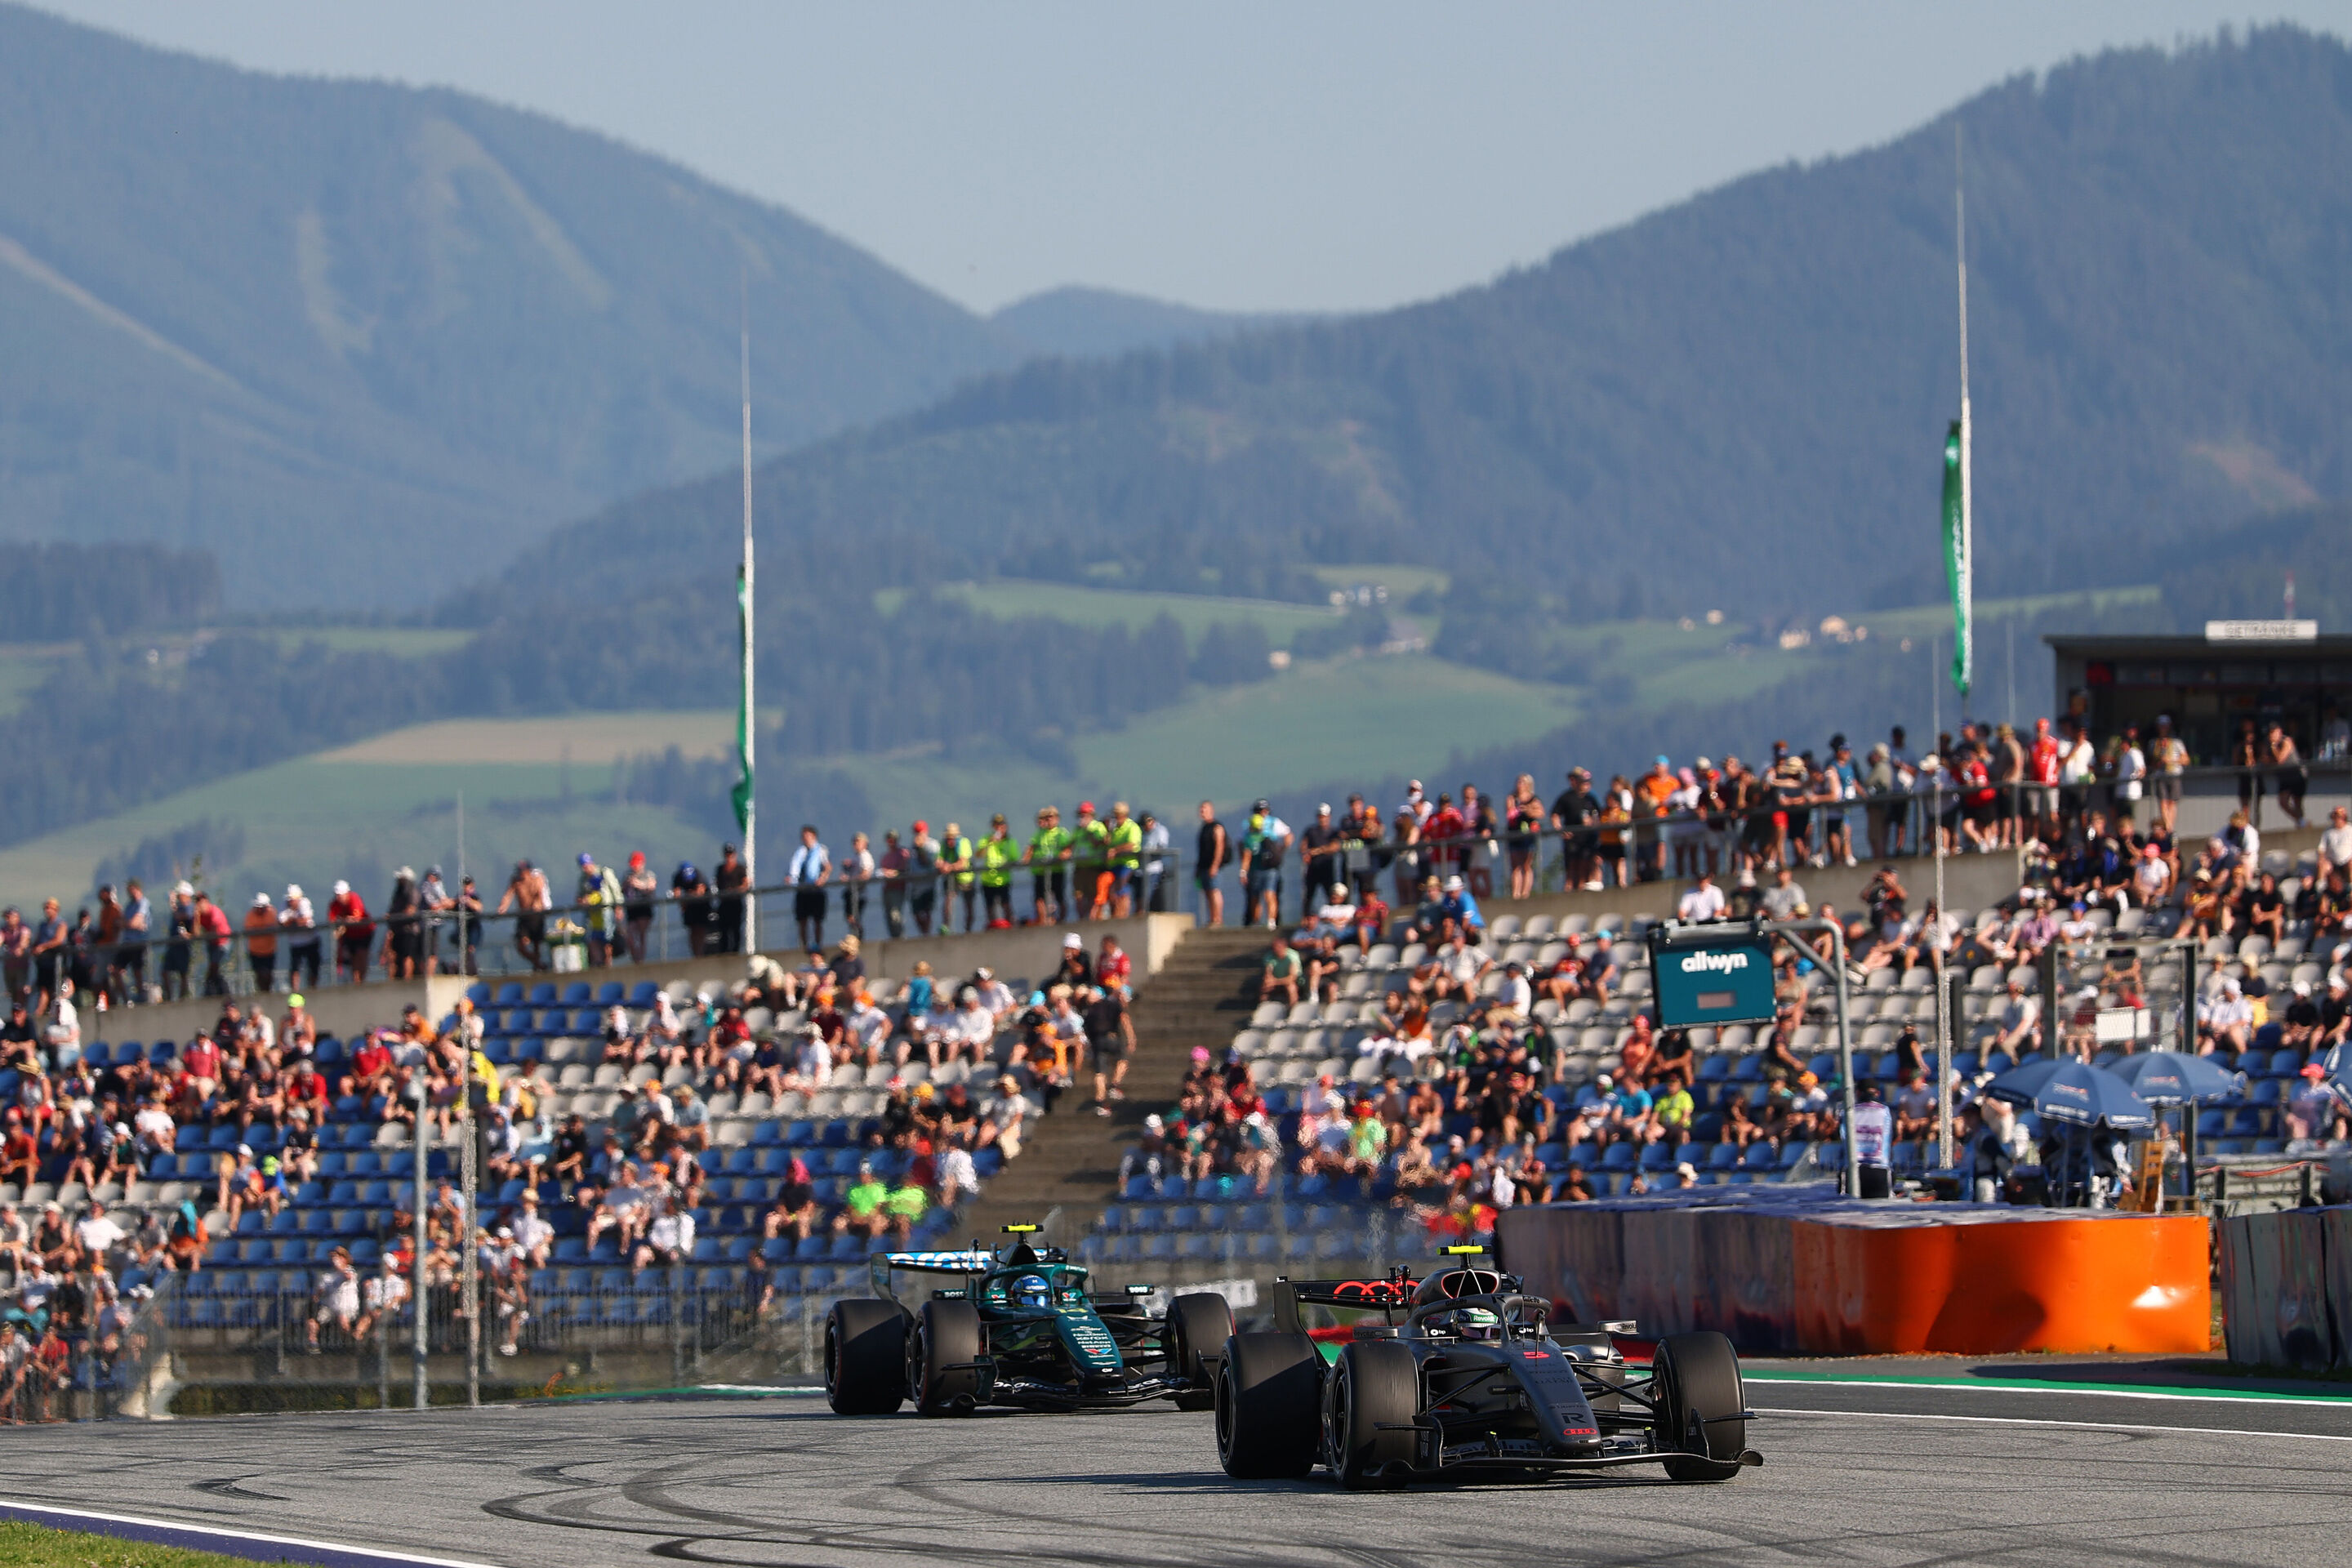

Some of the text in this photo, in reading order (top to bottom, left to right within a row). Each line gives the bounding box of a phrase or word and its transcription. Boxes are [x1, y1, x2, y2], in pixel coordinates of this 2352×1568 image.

[1681, 951, 1748, 974] allwyn
[1522, 1351, 1550, 1359] 5
[1561, 1412, 1587, 1423] R
